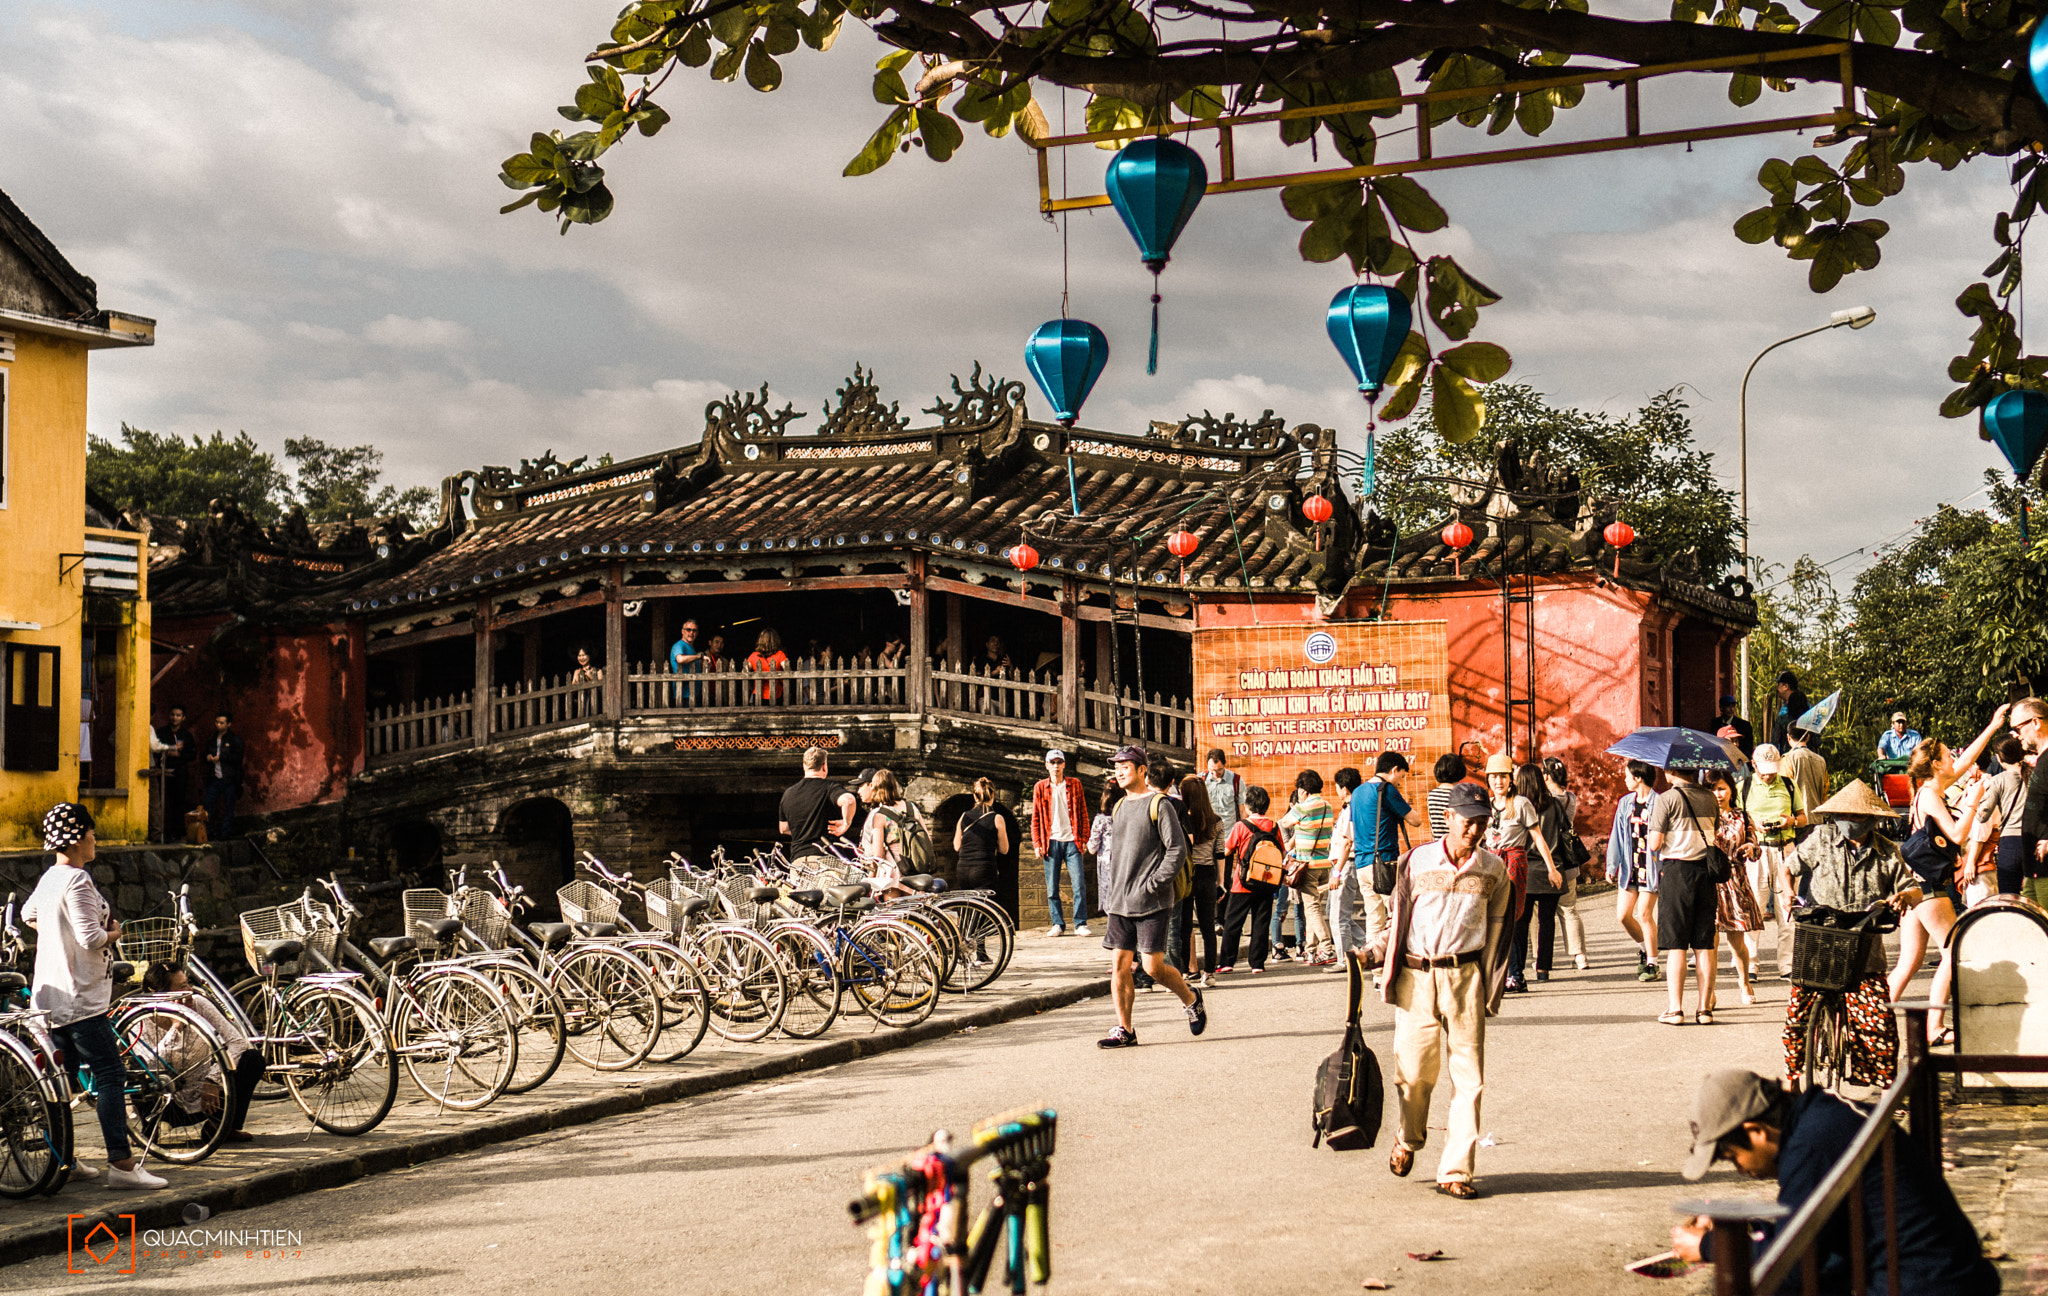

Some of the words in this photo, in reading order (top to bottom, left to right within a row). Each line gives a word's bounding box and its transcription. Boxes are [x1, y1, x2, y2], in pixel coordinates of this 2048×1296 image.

[1241, 668, 1267, 690] CHÀO
[1268, 667, 1289, 689] ĐÓN
[1290, 666, 1317, 688] ĐOÀN
[1319, 664, 1351, 688] KHÁCH
[1374, 663, 1397, 685] TIÊN
[1209, 693, 1230, 716] ĐẾN
[1230, 698, 1259, 716] THAM
[1260, 697, 1286, 717] QUAN
[1287, 696, 1308, 714] KHU
[1309, 688, 1329, 714] PHỐ
[1346, 690, 1363, 716] HỘI
[1365, 693, 1379, 712] AN
[1381, 689, 1404, 711] NĂM
[1405, 691, 1430, 711] 2017
[1213, 721, 1271, 736] WELCOME
[1274, 721, 1297, 734] THE
[1299, 720, 1331, 733] FIRST
[1334, 718, 1382, 733] TOURIST
[1385, 717, 1428, 731] GROUP
[1233, 742, 1249, 755] TO
[1253, 741, 1272, 758] HỘI
[1275, 742, 1291, 755] AN
[1293, 740, 1343, 755] ANCIENT
[1344, 739, 1379, 753] TOWN
[1385, 737, 1411, 752] 2017
